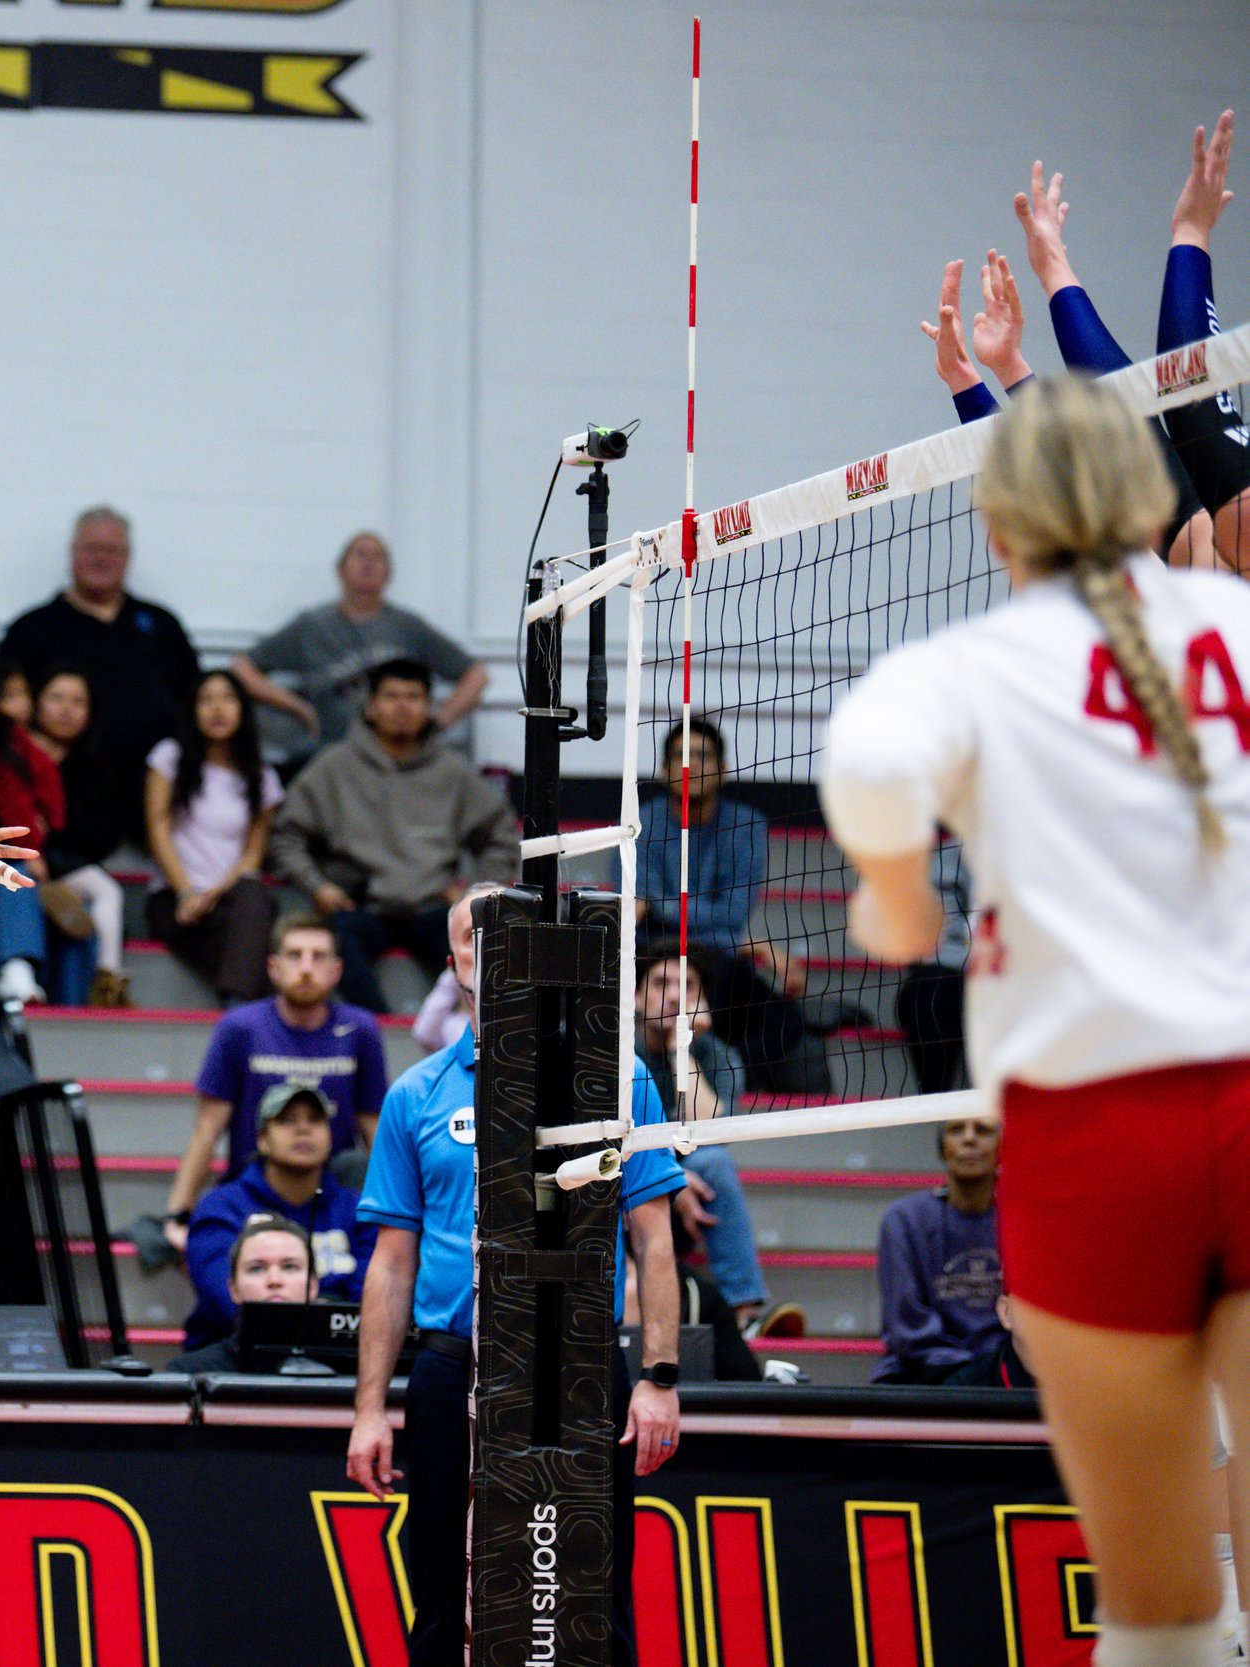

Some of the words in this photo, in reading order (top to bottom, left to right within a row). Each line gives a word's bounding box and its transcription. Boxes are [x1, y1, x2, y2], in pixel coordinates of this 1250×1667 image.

[1155, 341, 1207, 389] MARYLAND
[846, 452, 888, 494] MARYLAND
[1084, 627, 1250, 758] 44
[527, 1503, 560, 1611] sports
[525, 1618, 555, 1667] im
